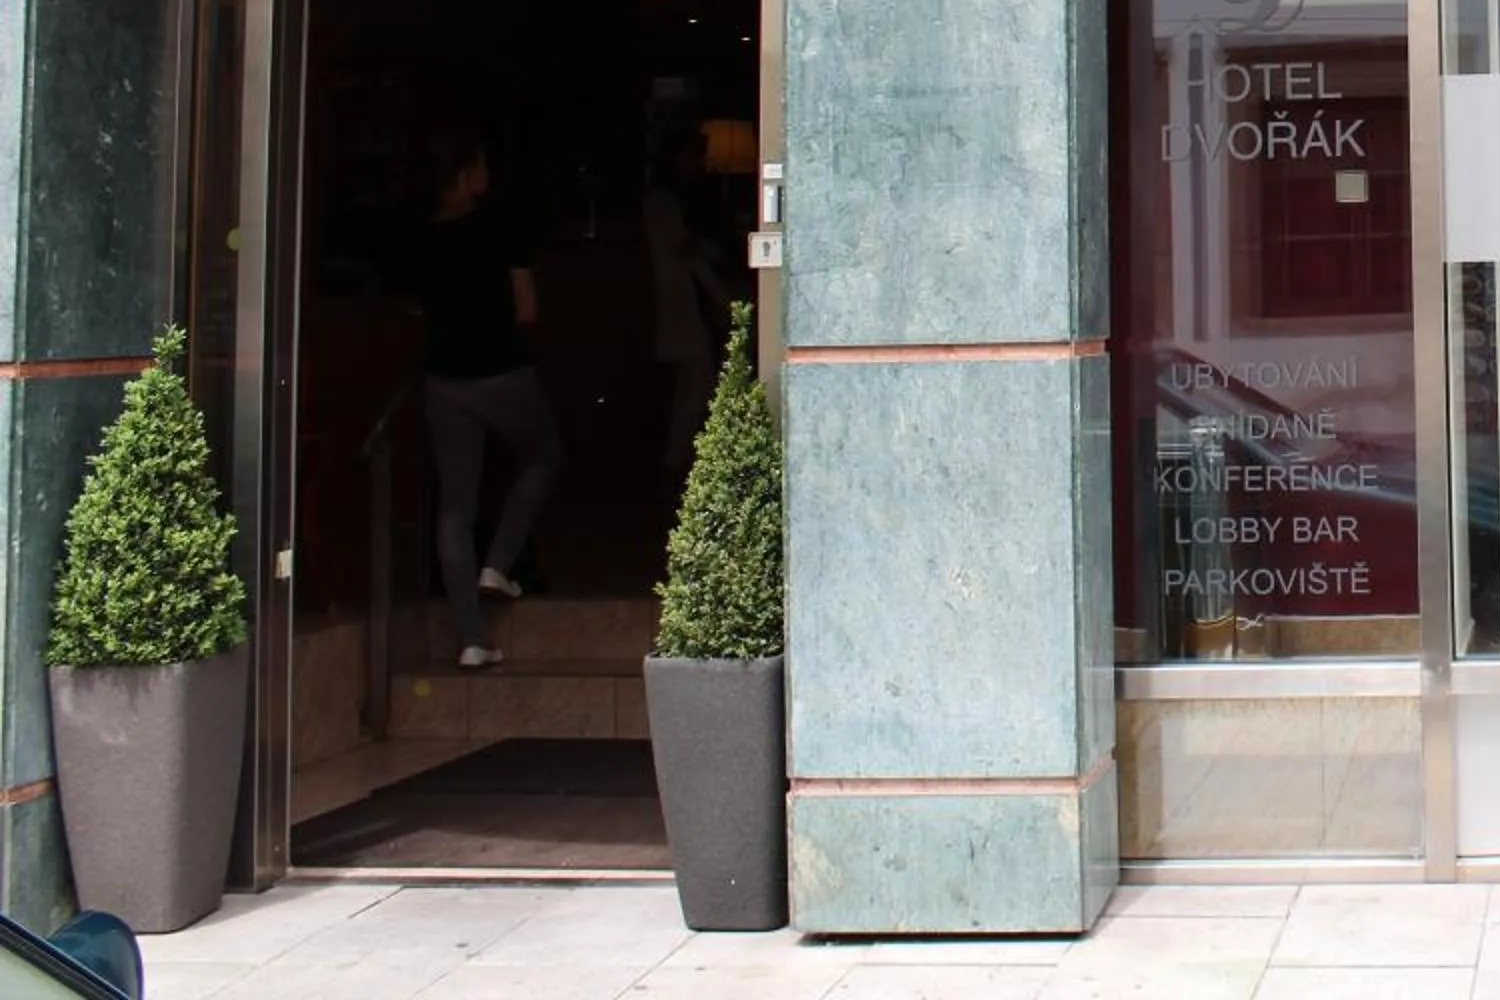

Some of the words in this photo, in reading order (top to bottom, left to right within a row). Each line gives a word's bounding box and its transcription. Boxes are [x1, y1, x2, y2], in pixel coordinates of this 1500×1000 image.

[1184, 62, 1342, 102] HOTEL
[1162, 110, 1367, 161] DVOŘÁK
[1171, 354, 1360, 390] UBYTOVÁNÍ
[1194, 407, 1337, 442] NÍDANĚ
[1154, 464, 1379, 492] KONFERENCE
[1174, 517, 1283, 544] LOBBY
[1293, 516, 1360, 543] BAR
[1164, 562, 1372, 596] PARKOVIŠTĚ
